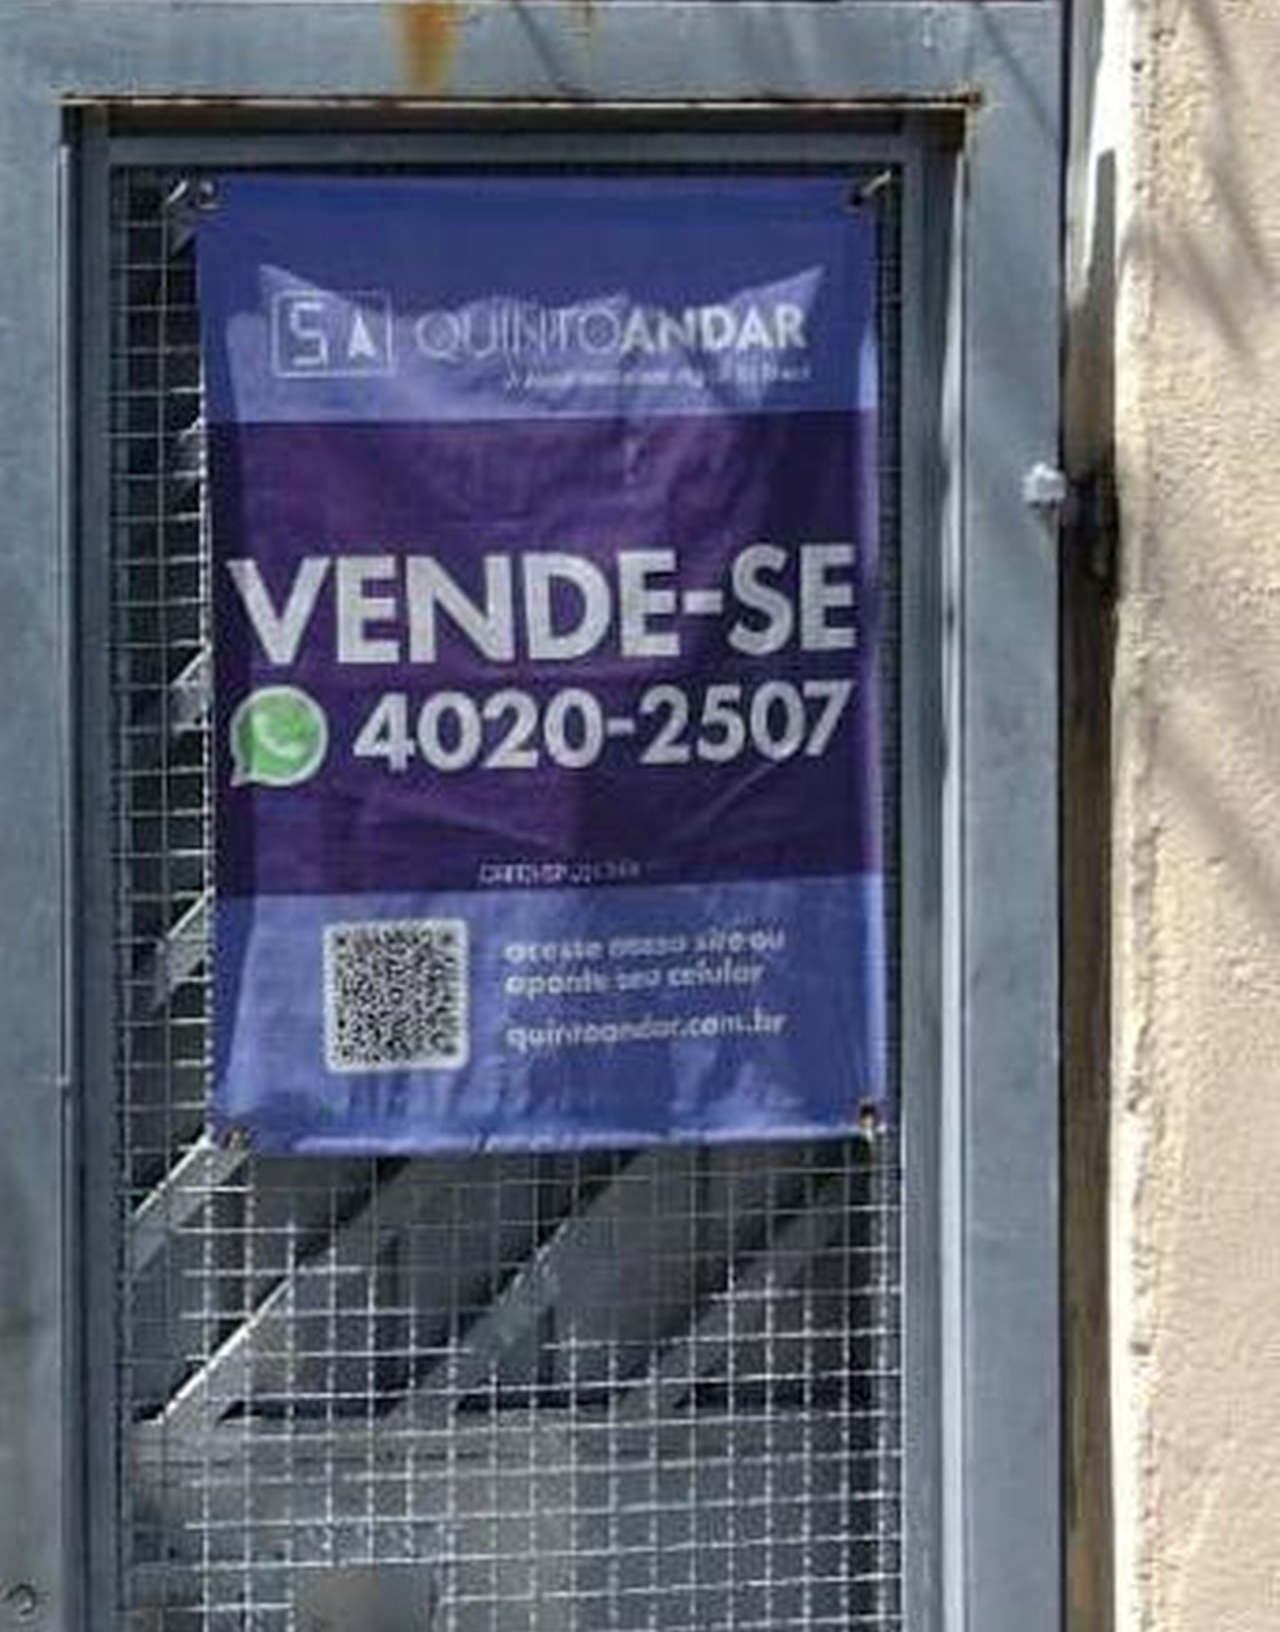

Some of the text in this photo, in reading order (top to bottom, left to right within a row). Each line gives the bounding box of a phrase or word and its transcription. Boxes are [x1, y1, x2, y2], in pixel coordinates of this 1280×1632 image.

[414, 301, 807, 361] QUINTOANDAR
[226, 544, 856, 665] VENDE-SE
[352, 680, 854, 772] 4020-2507
[667, 957, 765, 986] celular
[506, 1005, 788, 1052] quintoandar.com.br
